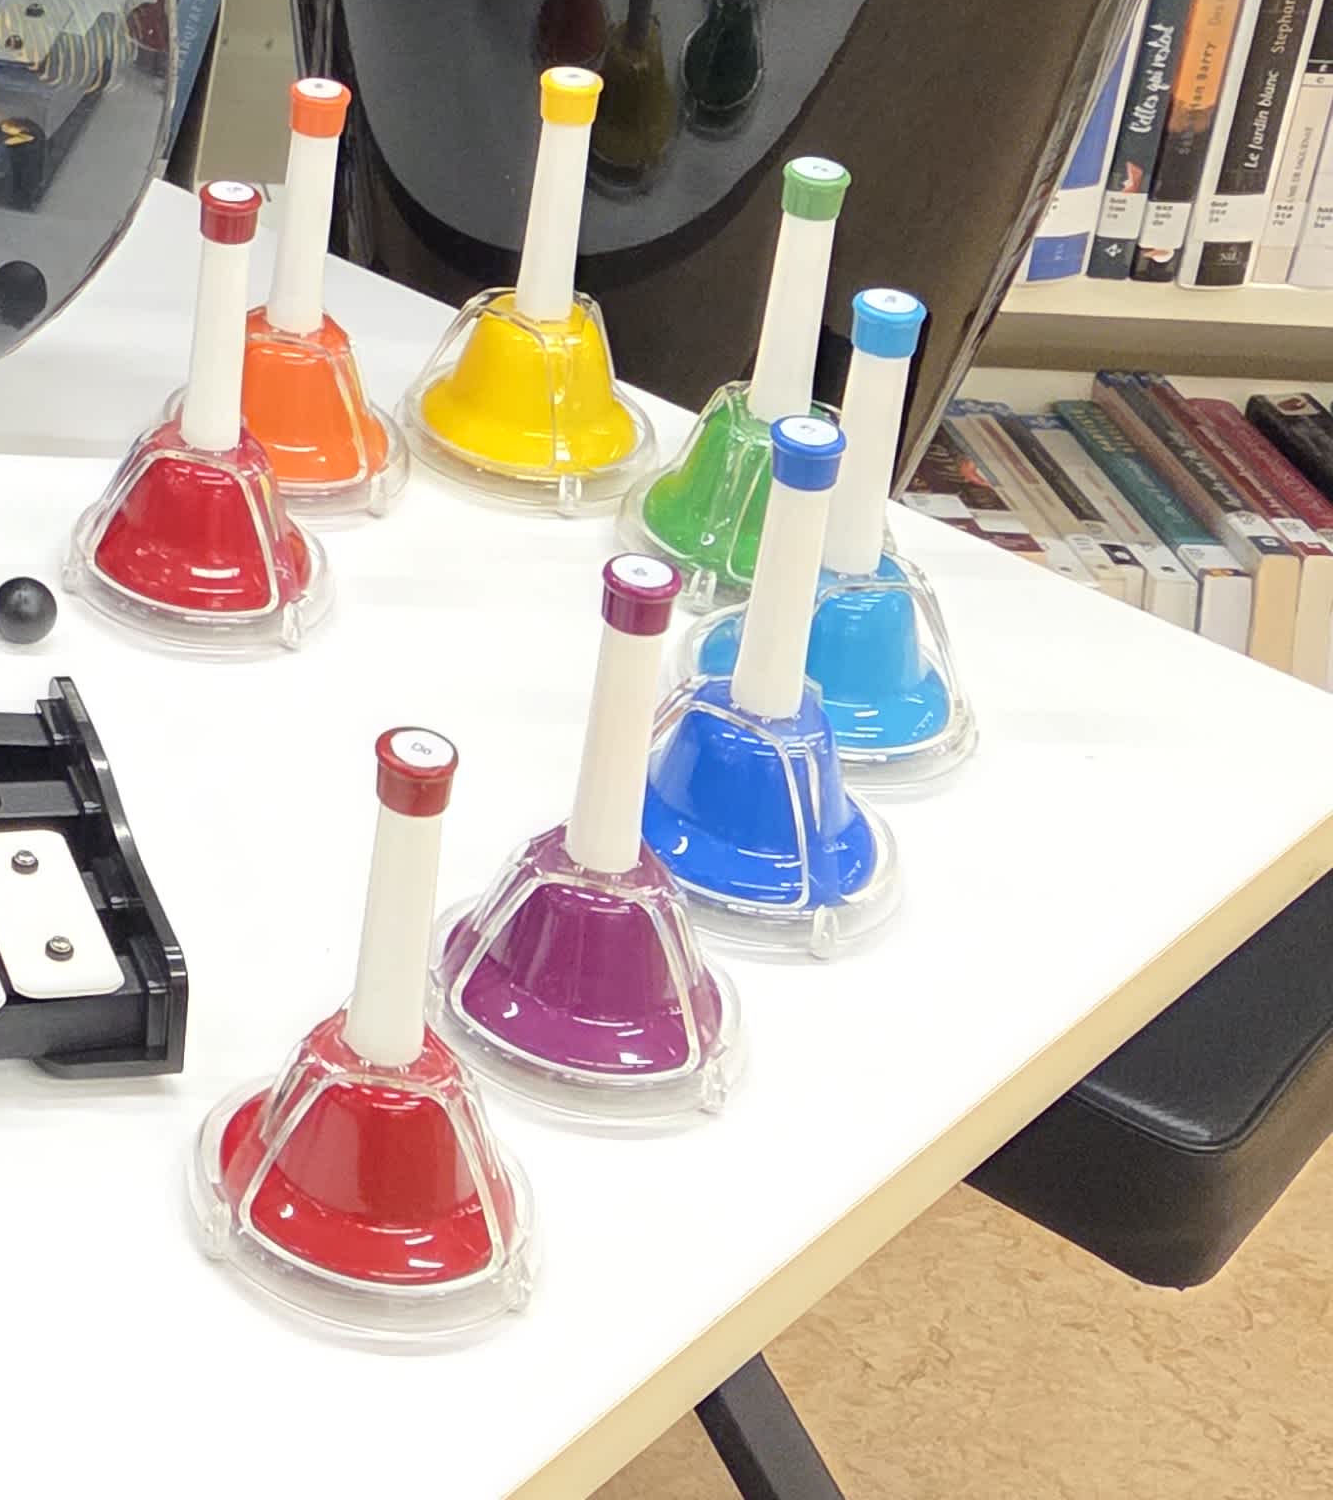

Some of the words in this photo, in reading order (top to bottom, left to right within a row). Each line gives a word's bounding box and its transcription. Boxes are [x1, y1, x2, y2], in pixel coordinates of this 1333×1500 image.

[1258, 68, 1279, 109] blanc
[1251, 109, 1271, 147] Jardin
[1242, 148, 1260, 169] Le
